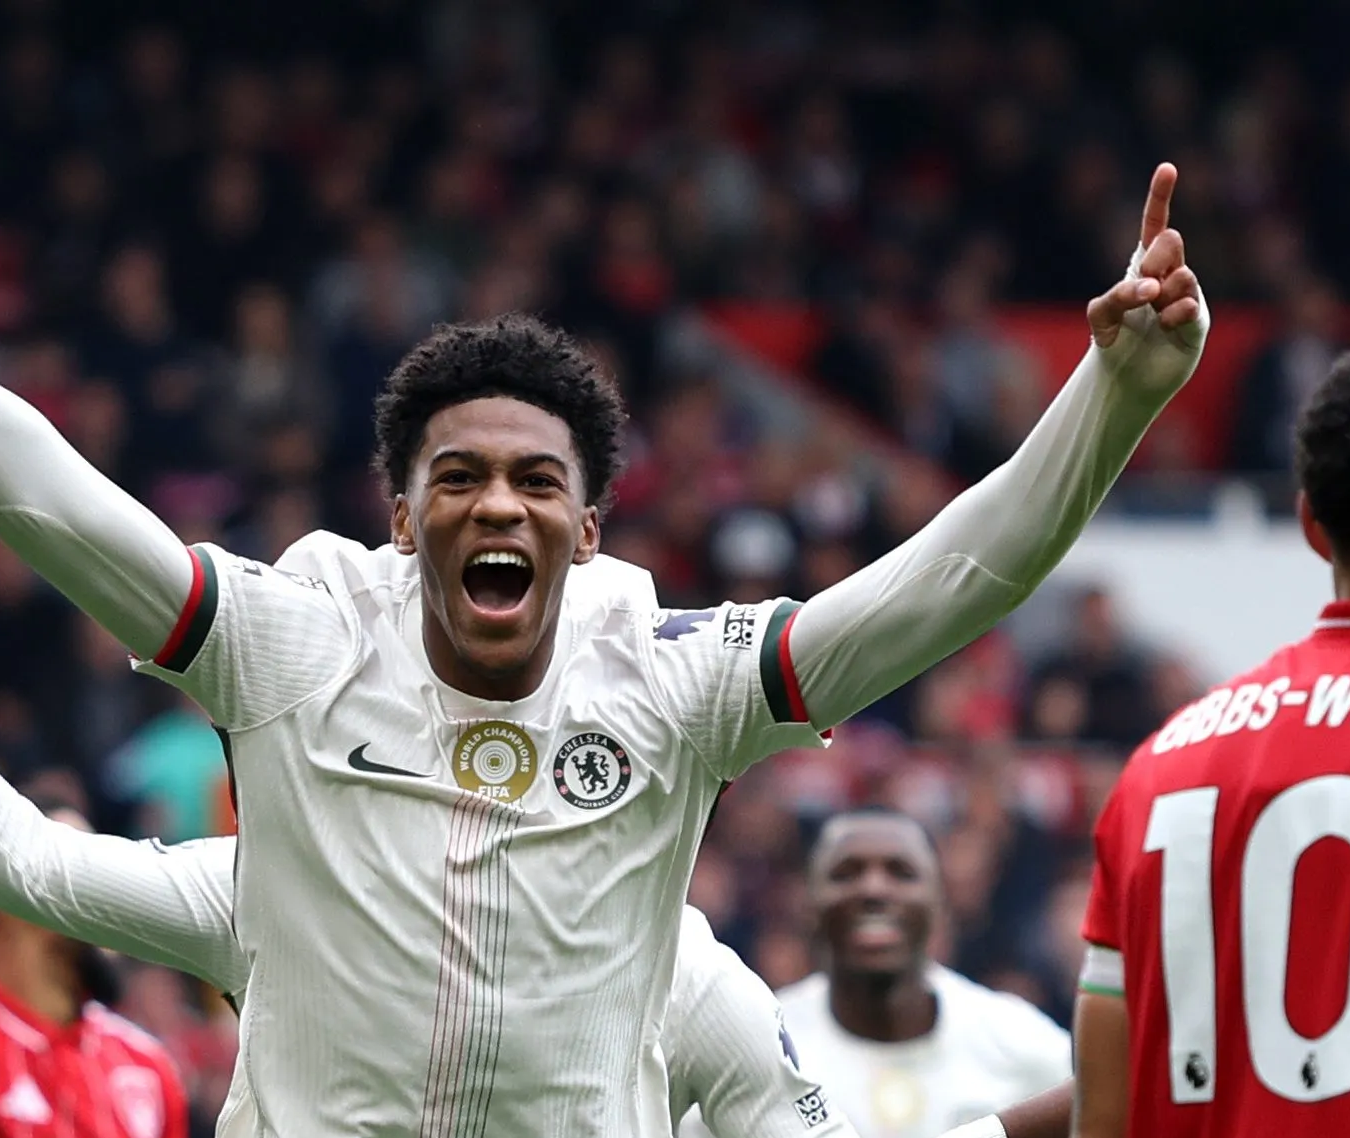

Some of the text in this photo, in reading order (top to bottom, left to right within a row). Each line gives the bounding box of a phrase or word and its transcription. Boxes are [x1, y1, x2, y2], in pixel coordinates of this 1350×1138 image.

[459, 727, 530, 773] WORLD CHAMPIONS
[559, 734, 608, 759] CHELSEA
[477, 785, 510, 798] FIFA
[794, 1095, 820, 1117] No
